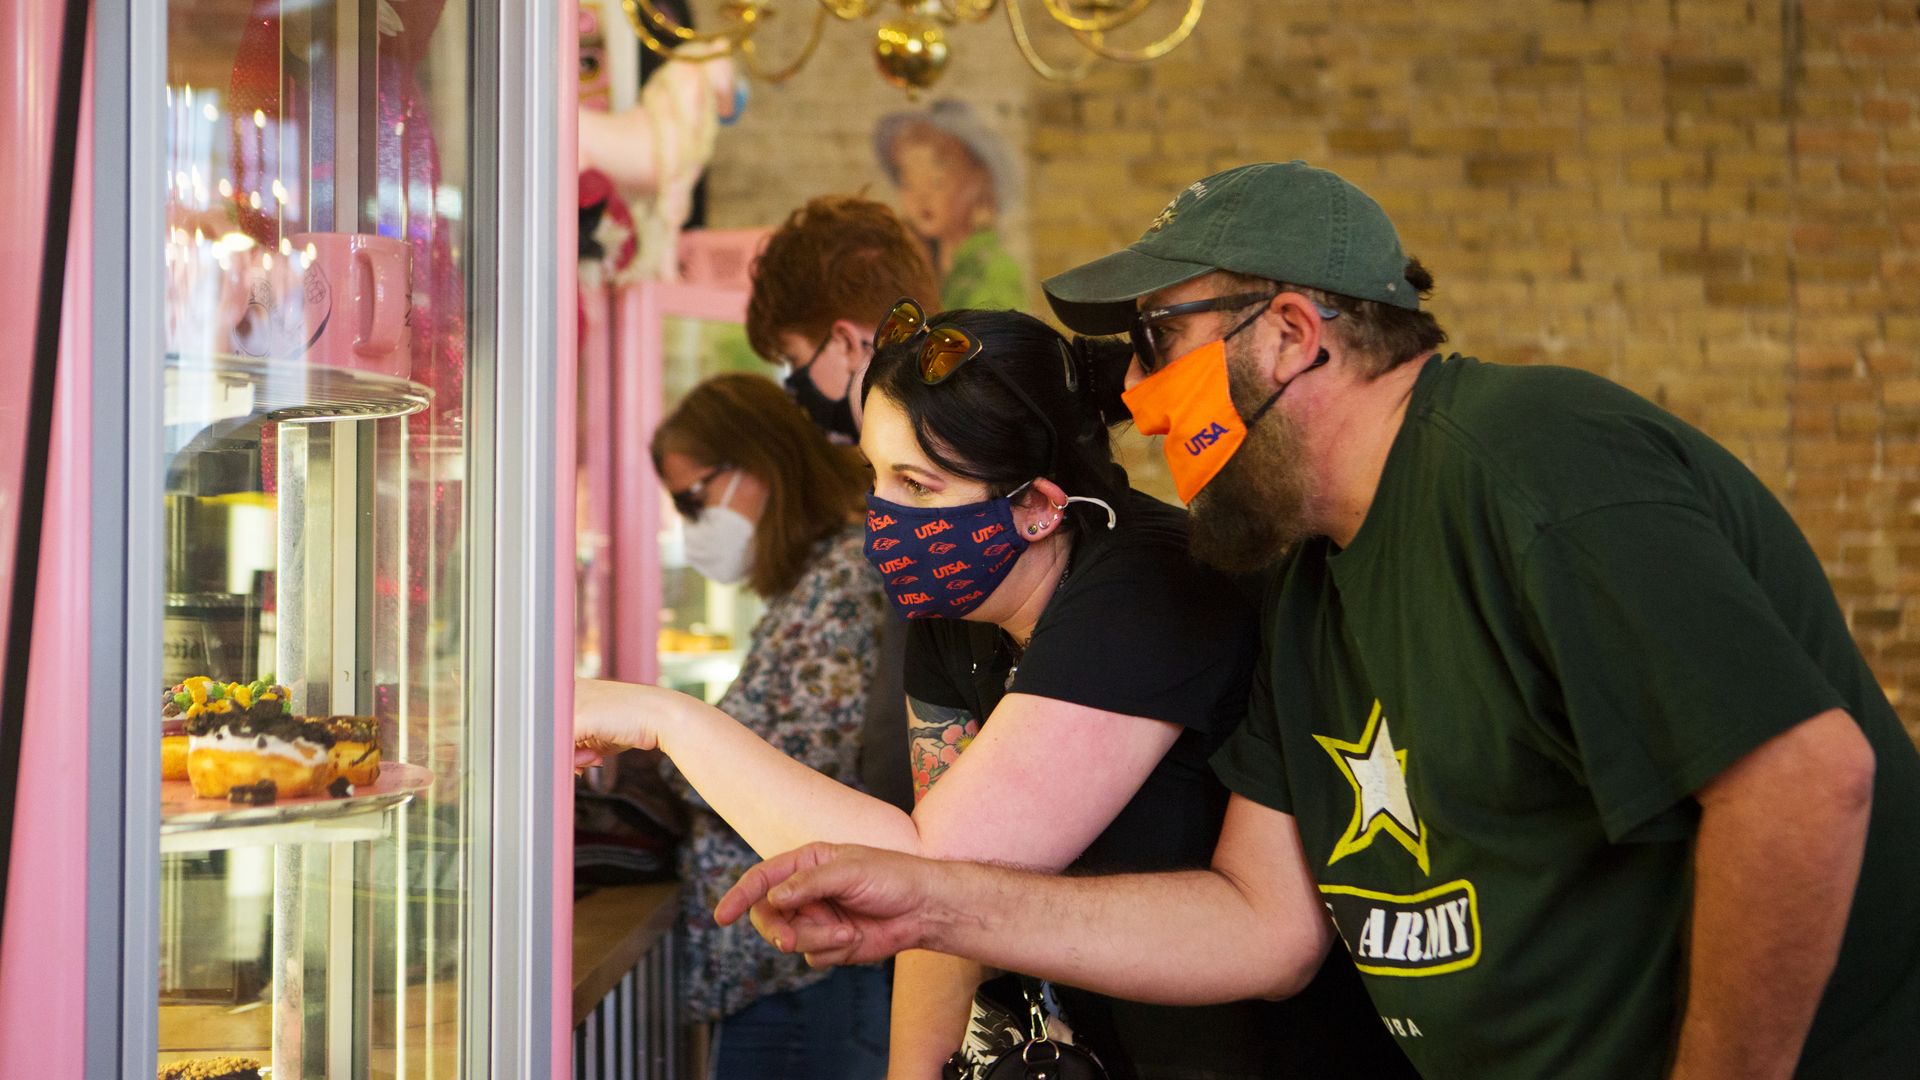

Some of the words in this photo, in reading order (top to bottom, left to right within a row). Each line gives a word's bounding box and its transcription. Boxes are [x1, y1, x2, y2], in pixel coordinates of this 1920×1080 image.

[1184, 422, 1230, 457] UTSA
[868, 514, 897, 535] TSA
[914, 519, 951, 540] UTSA
[971, 523, 1005, 544] UTSA
[879, 556, 914, 575] UTSA
[932, 560, 969, 580] UTSA
[897, 592, 932, 606] UTSA
[950, 590, 984, 606] UTSA
[1358, 897, 1470, 962] ARMY
